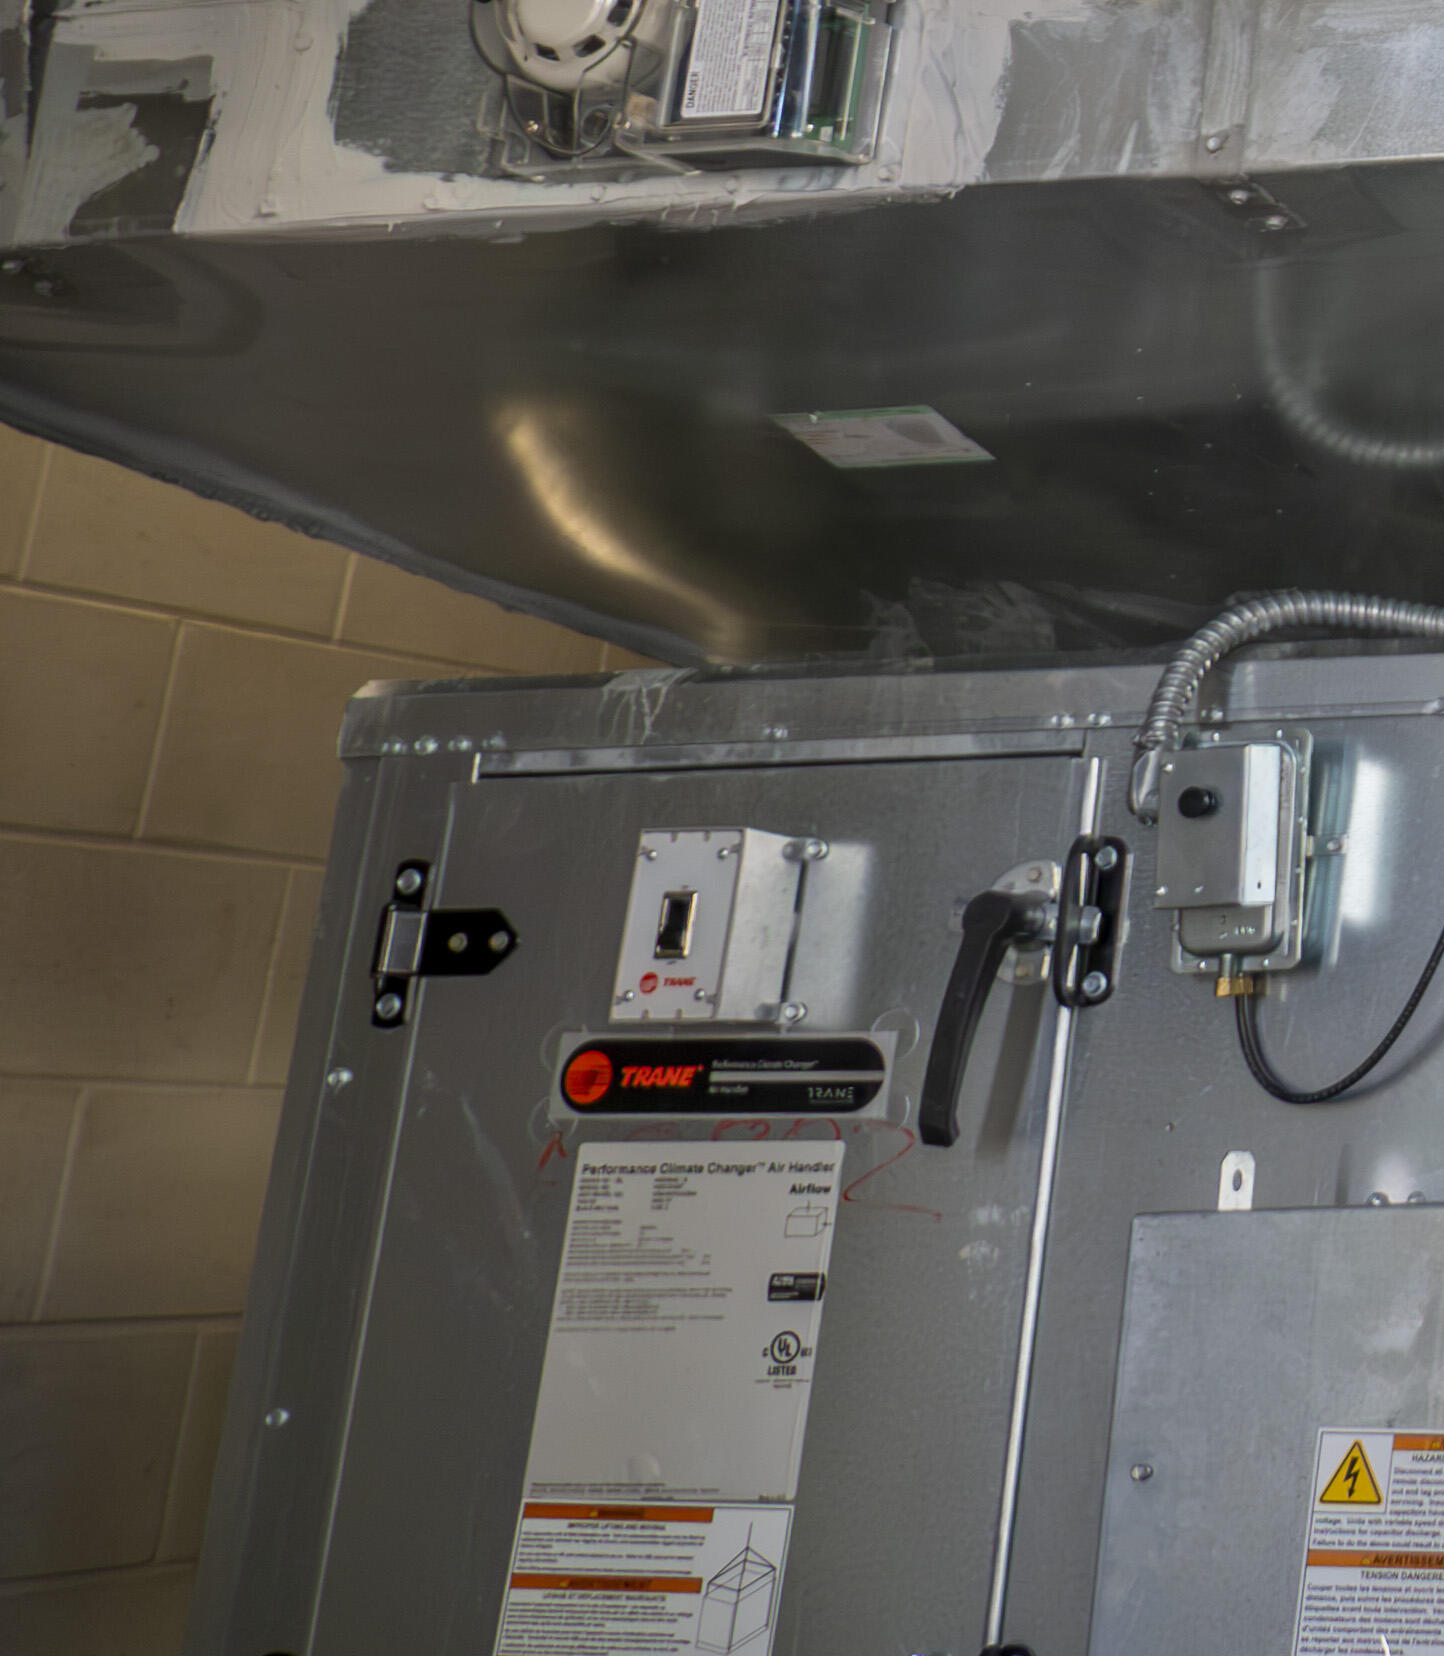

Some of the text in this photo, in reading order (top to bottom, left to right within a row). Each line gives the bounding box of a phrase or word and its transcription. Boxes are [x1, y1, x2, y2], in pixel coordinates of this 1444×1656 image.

[686, 71, 700, 109] DANGER
[581, 1162, 655, 1175] Performance
[660, 1162, 704, 1175] Climate
[767, 1162, 784, 1173] Air
[788, 1161, 836, 1173] Handler
[789, 1183, 832, 1195] Airflow
[1361, 1570, 1399, 1579] TENSION
